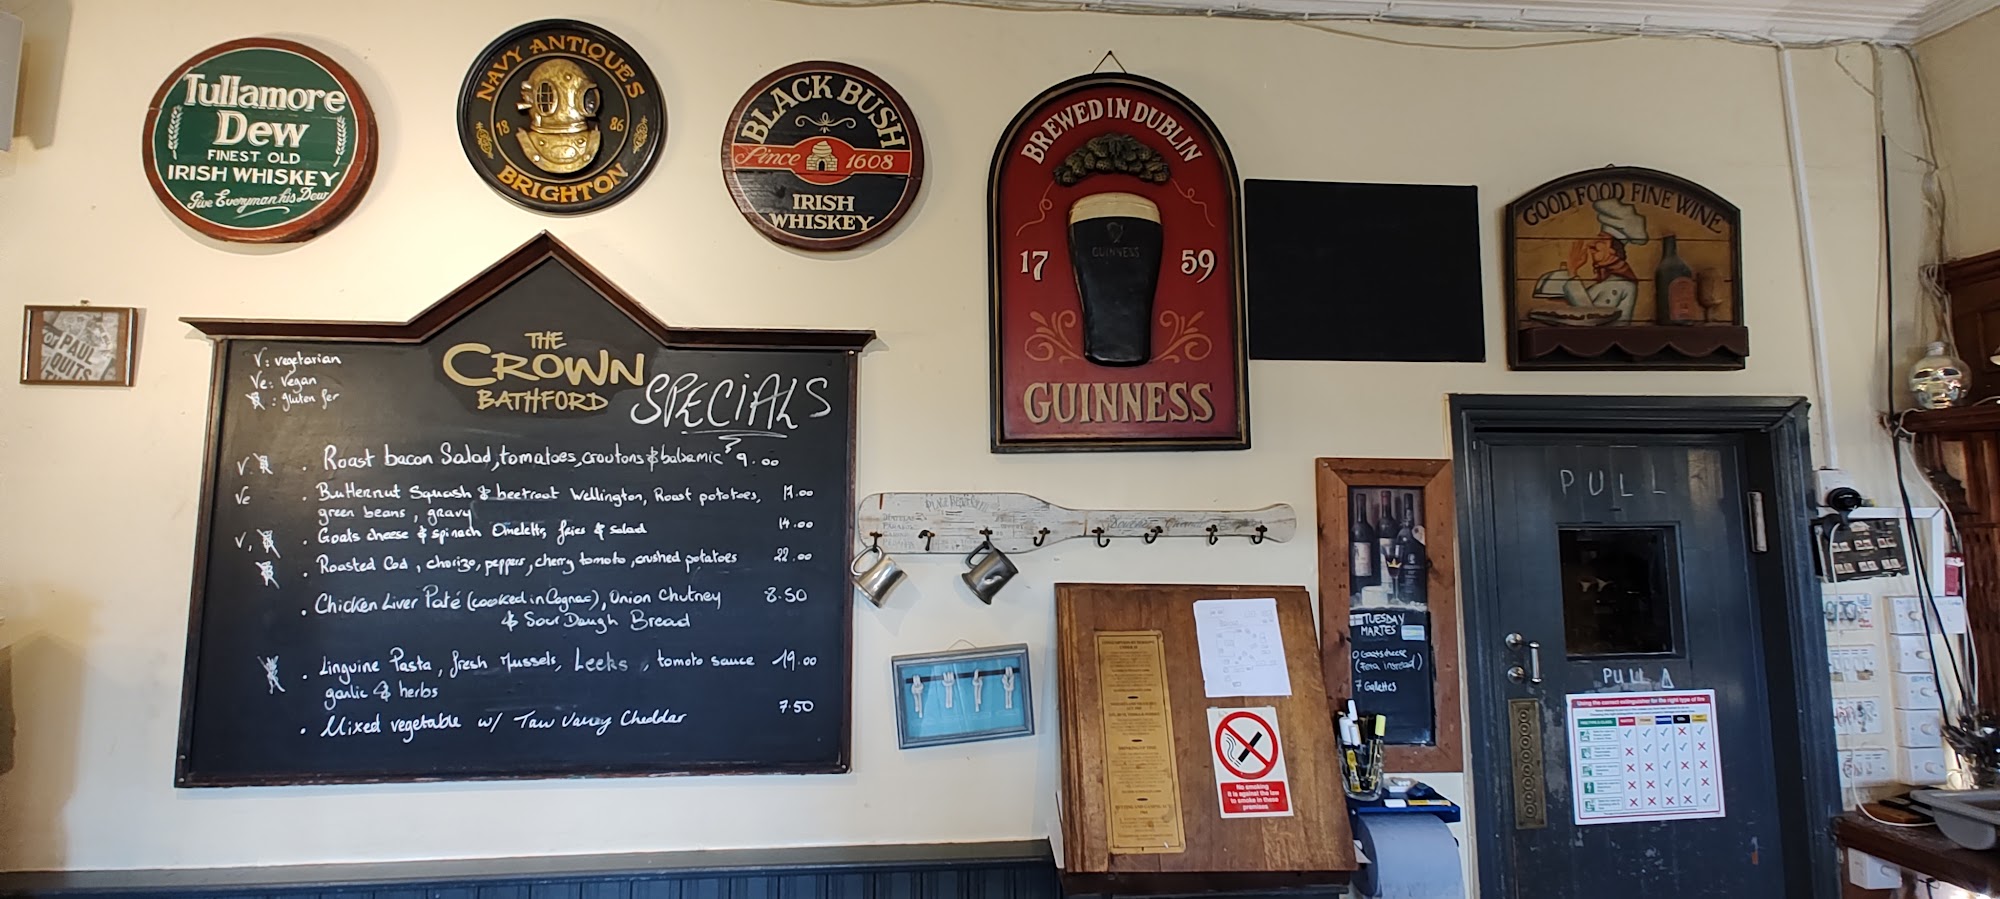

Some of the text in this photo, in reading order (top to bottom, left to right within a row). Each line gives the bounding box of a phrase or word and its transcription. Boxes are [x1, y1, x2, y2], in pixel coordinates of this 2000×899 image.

[476, 35, 645, 101] NAVY ANTIQUES
[183, 73, 346, 114] Tullamore
[741, 75, 906, 148] BLACK BUSH
[212, 109, 310, 148] Dew
[496, 117, 625, 136] 18 86
[1021, 97, 1203, 164] BREWED IN DUBLIN
[208, 149, 301, 164] FINEST OLD
[735, 146, 894, 170] Since 1608
[168, 165, 340, 187] IRISH WHISKEY
[497, 162, 629, 203] BRIGHTON
[187, 187, 330, 214] Give Everyman his Dew
[792, 194, 854, 212] IRISH
[1522, 182, 1725, 234] GOOD FOOD FINE WINE
[769, 213, 875, 231] WHISKEY
[1092, 246, 1140, 258] GUINNESS
[1020, 249, 1215, 284] 17 59
[59, 333, 95, 365] PAUL
[525, 331, 567, 350] THE
[50, 352, 92, 381] QUITS
[275, 351, 342, 373] vegetarian
[442, 342, 645, 387] CROWN
[281, 394, 316, 412] gluten
[477, 388, 609, 413] BATHFORD
[1023, 381, 1215, 424] GUINNESS
[323, 445, 375, 471] Roast
[384, 444, 433, 465] bacon
[647, 446, 658, 472] &
[660, 445, 723, 465] balsamic
[1560, 465, 1667, 496] PULL
[409, 484, 472, 504] Squash
[478, 484, 491, 501] &
[496, 483, 560, 500] beetroot
[569, 487, 647, 508] Wellington,
[653, 488, 693, 502] Roast
[318, 508, 355, 527] green
[318, 527, 361, 545] Goats
[366, 529, 409, 542] cheese
[417, 526, 427, 545] &
[431, 525, 482, 545] spinach
[594, 522, 605, 540] &
[316, 554, 377, 573] Roasted
[535, 553, 575, 575] cherry
[685, 549, 738, 573] potatoes
[773, 548, 812, 562] 22.00
[315, 593, 377, 614] Chicken
[382, 593, 418, 611] Liver
[467, 590, 526, 611] (cooked
[530, 594, 545, 605] in
[609, 589, 651, 604] Onion
[658, 585, 721, 609] Chutney
[501, 609, 690, 634] & Sour Dough Bread
[1360, 625, 1397, 637] MARTES
[1363, 613, 1405, 626] TUESDAY
[319, 656, 380, 685] Linguine
[450, 650, 487, 678] fresh
[710, 655, 755, 667] sauce
[1603, 668, 1645, 684] PULL
[324, 680, 438, 710] garlic & herbs
[1355, 679, 1362, 692] 7
[320, 714, 382, 738] Mixed
[391, 713, 462, 743] vegetable
[620, 709, 688, 726] Cheddar
